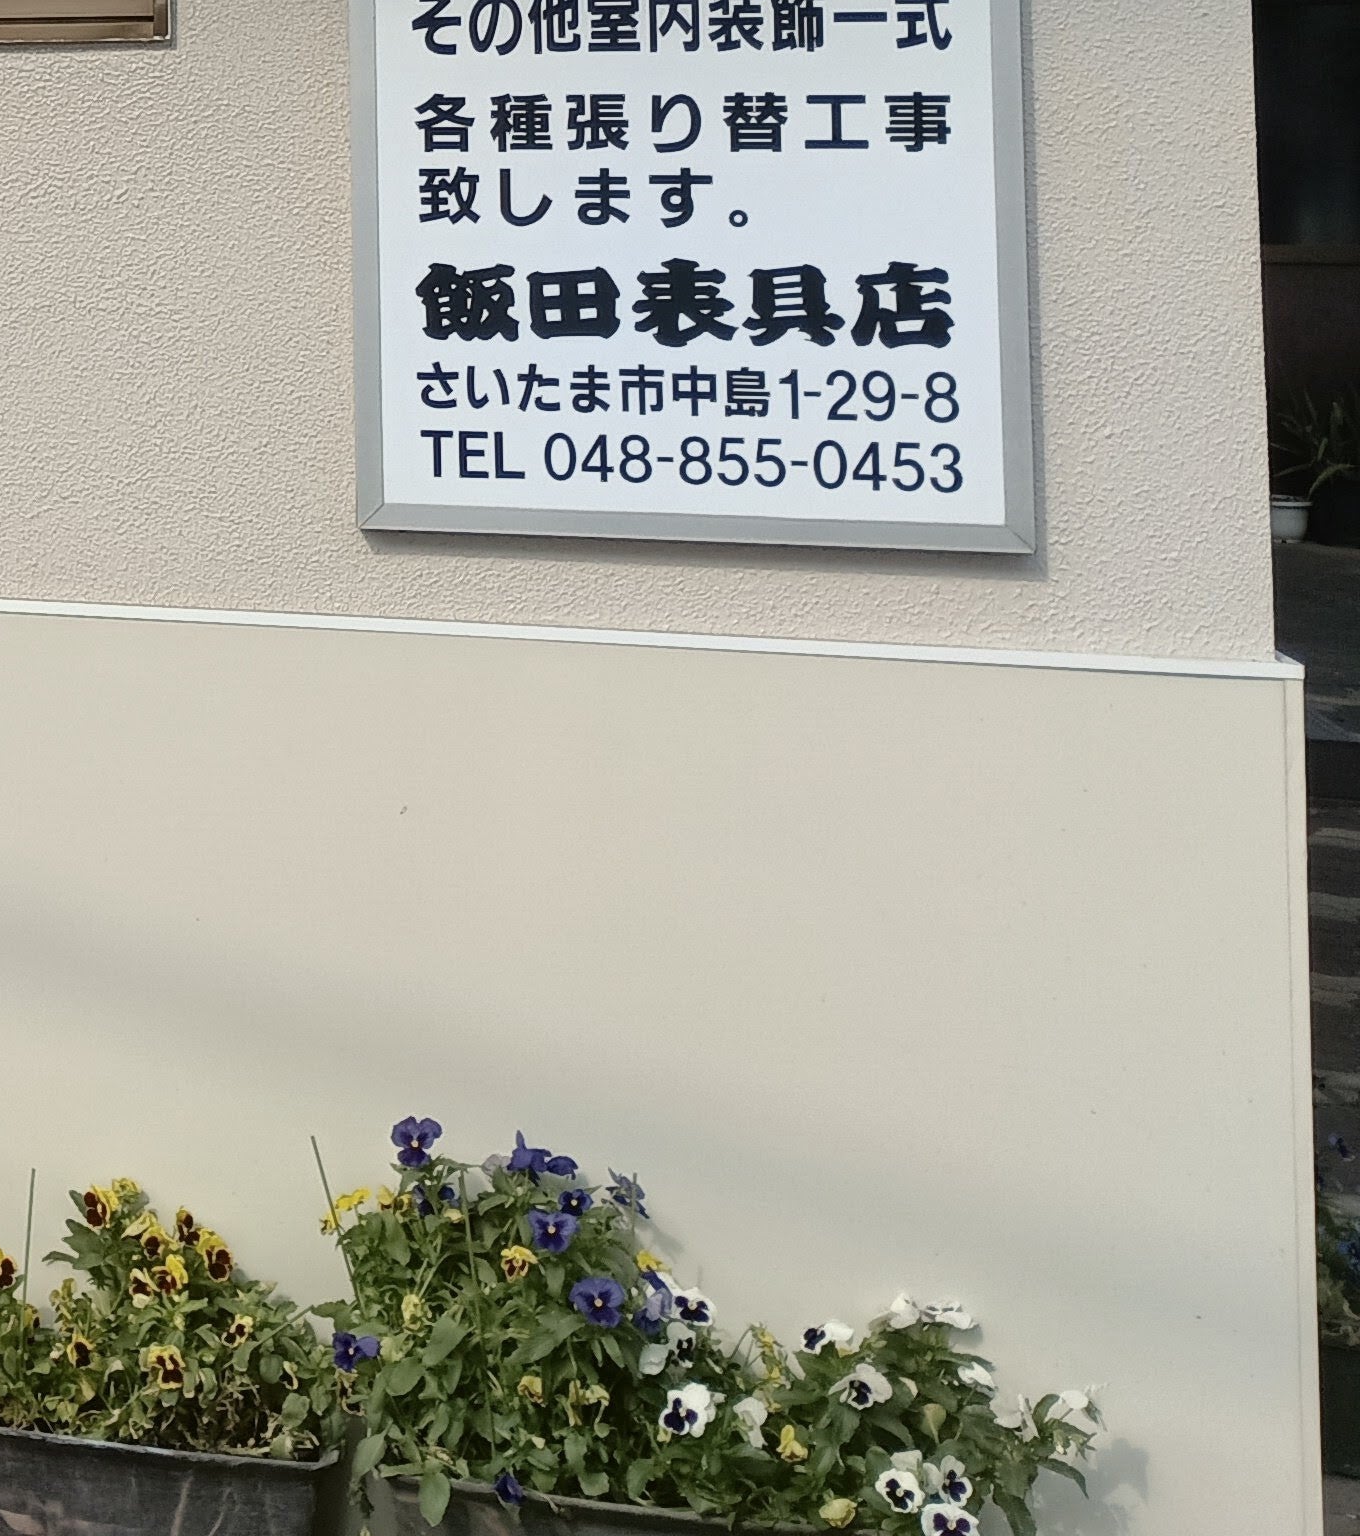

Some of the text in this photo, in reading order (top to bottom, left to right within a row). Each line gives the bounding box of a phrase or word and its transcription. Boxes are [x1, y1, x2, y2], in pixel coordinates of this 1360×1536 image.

[414, 91, 952, 154] 各種張り替工事
[418, 166, 750, 229] 致します。
[414, 257, 956, 349] 飯田表具店
[416, 361, 961, 424] さいたま市中島1-29-8
[420, 429, 964, 494] TEL 048-855-0453
